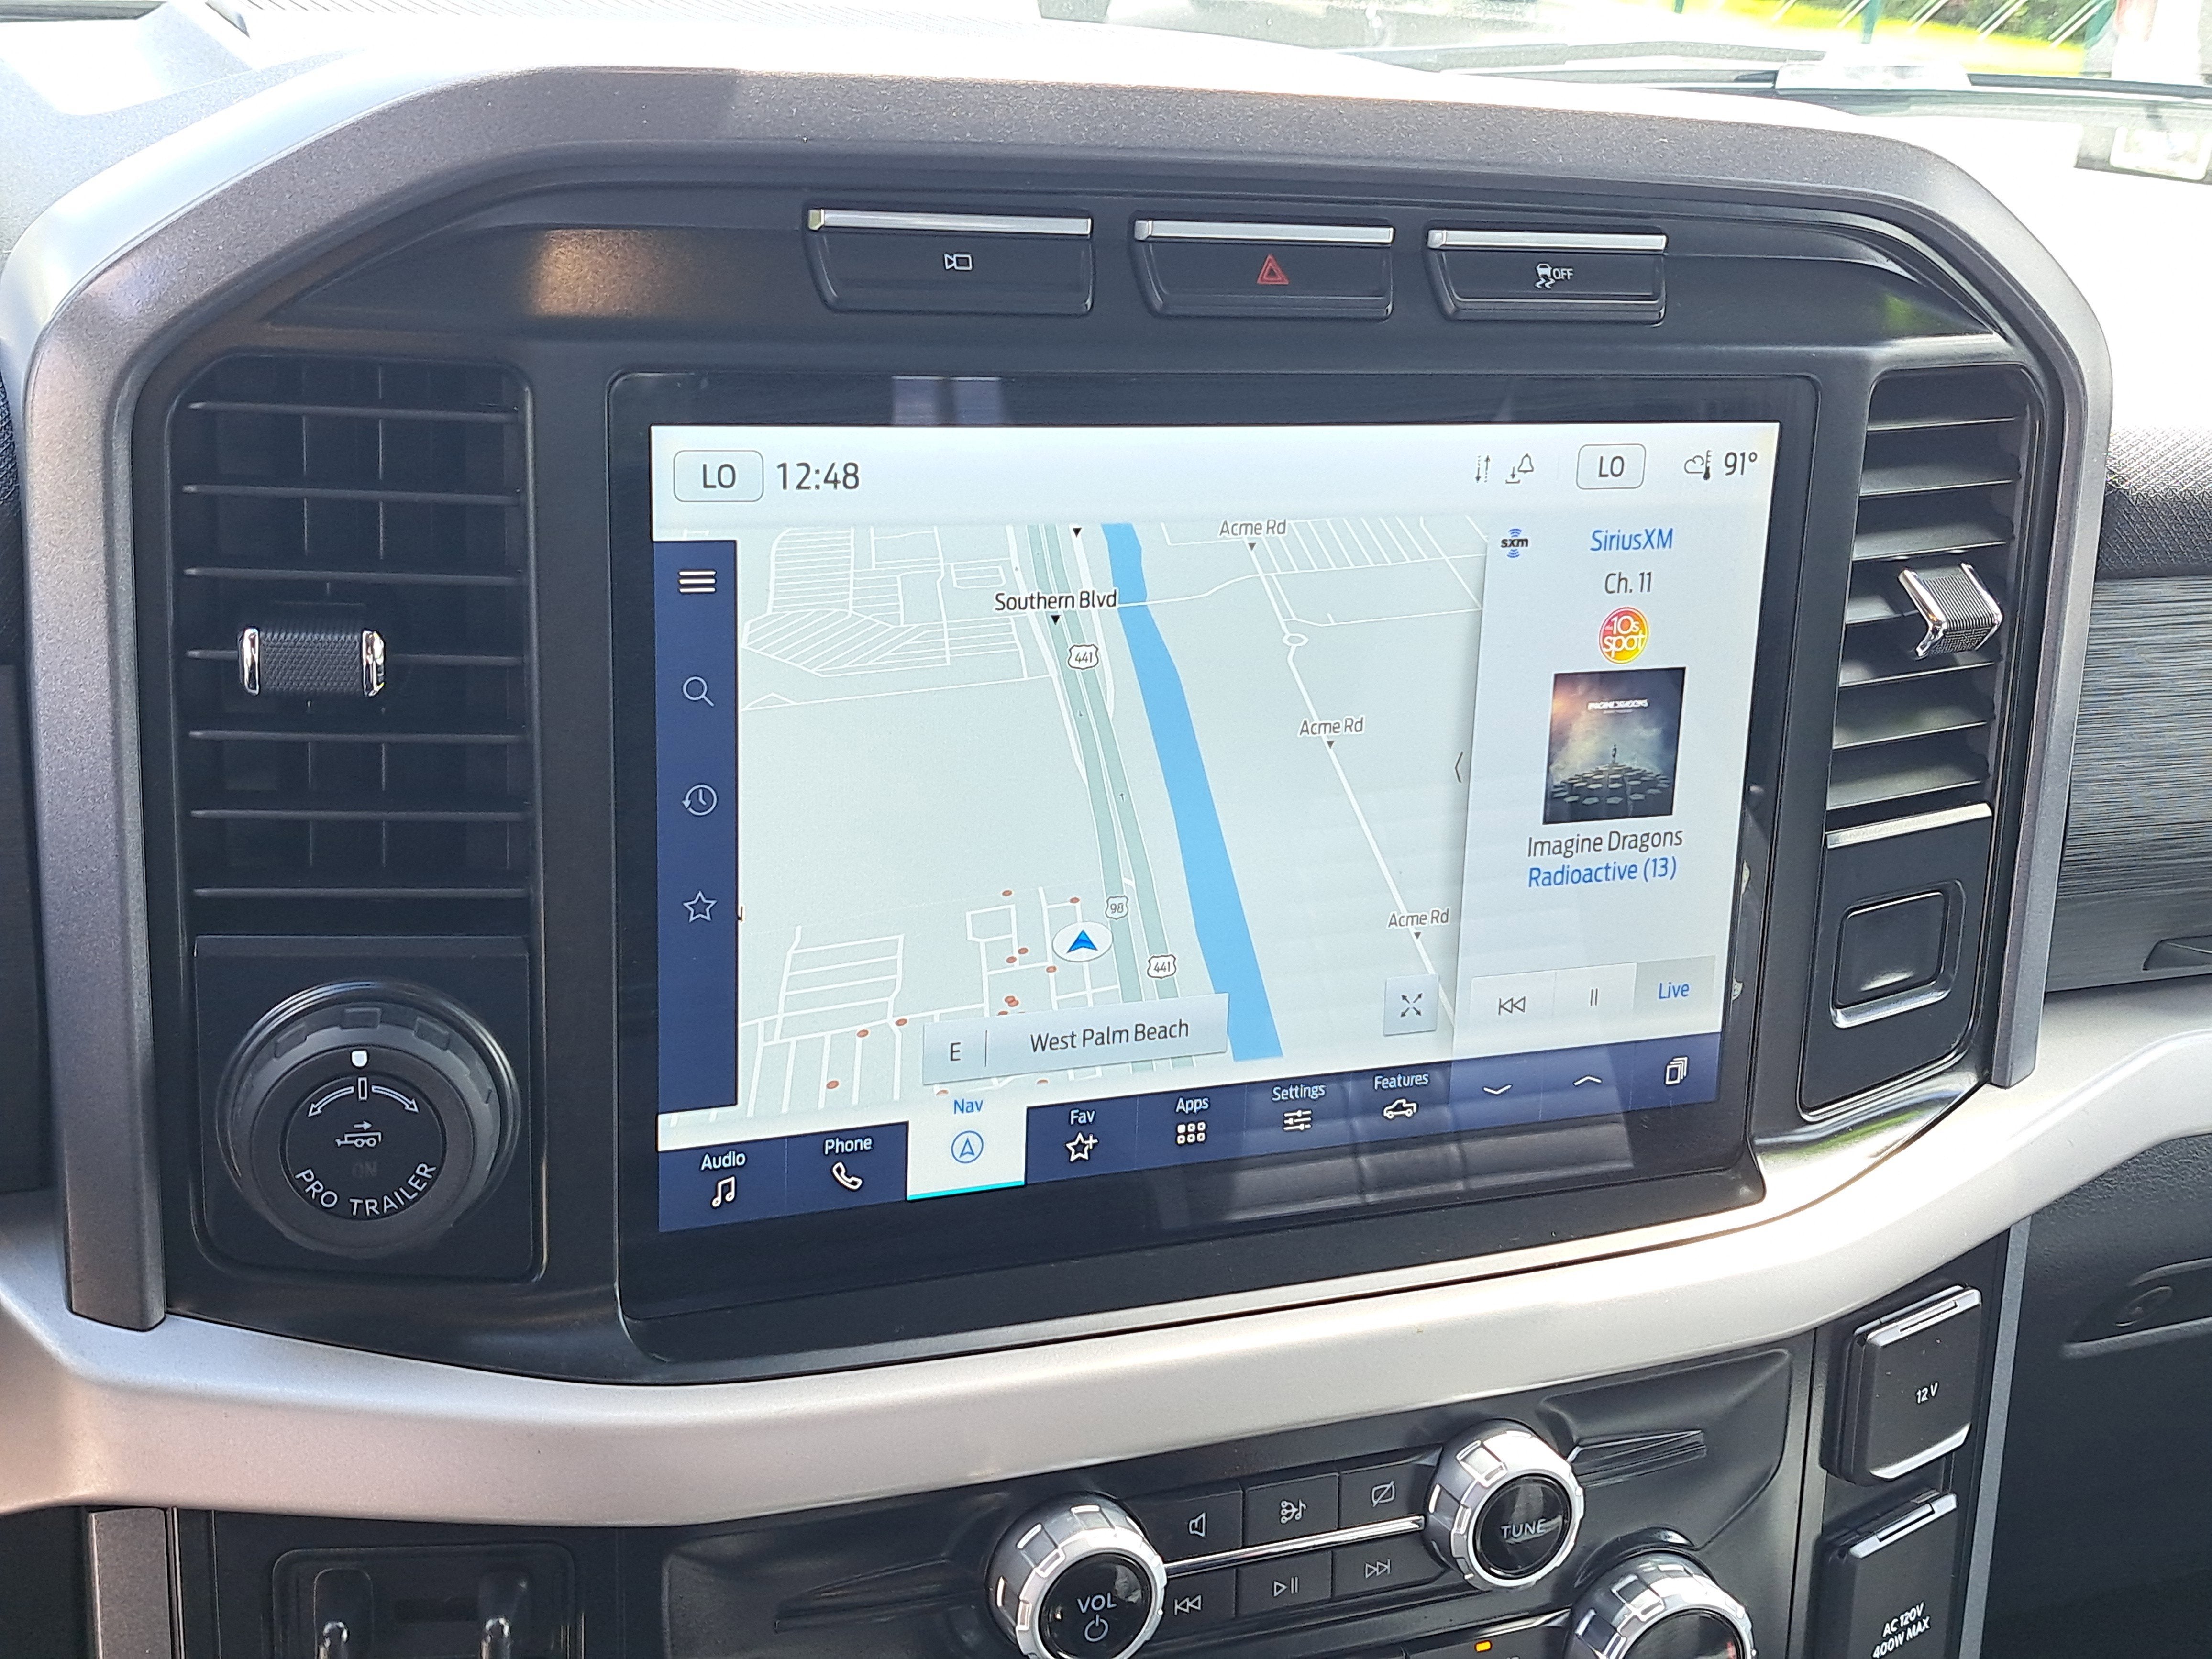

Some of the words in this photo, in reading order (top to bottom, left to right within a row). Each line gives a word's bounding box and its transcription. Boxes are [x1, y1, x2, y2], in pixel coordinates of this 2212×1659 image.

[1552, 268, 1574, 280] OFF
[702, 464, 736, 488] LO
[777, 462, 860, 490] 12:48
[1598, 456, 1625, 478] LO
[1219, 521, 1262, 536] Acme
[1265, 520, 1286, 535] Rd
[1590, 528, 1673, 551] SiriusXM
[1604, 574, 1633, 594] Ch.
[1639, 572, 1652, 593] 11
[995, 592, 1075, 611] Southern
[1080, 590, 1117, 609] Blvd
[1602, 630, 1646, 658] spot
[1074, 651, 1093, 664] 441
[1299, 719, 1340, 736] Acme
[1345, 717, 1363, 733] Rd
[1528, 833, 1603, 860] Imagine
[1609, 829, 1683, 853] Dragons
[1528, 861, 1638, 887] Radioactive
[1644, 856, 1676, 882] (13)
[1388, 911, 1427, 928] Acme
[1431, 908, 1449, 924] Rd
[1153, 961, 1172, 973] 441
[1659, 980, 1690, 1000] Live
[950, 1042, 962, 1062] E
[1030, 1031, 1077, 1052] West
[1083, 1027, 1129, 1047] Palm
[1135, 1019, 1189, 1042] Beach
[1374, 1073, 1429, 1092] Features
[1272, 1083, 1327, 1103] Settings
[953, 1100, 984, 1115] Nav
[1175, 1096, 1209, 1113] Apps
[1070, 1110, 1095, 1125] Fav
[824, 1137, 872, 1155] Phone
[352, 1162, 377, 1178] ON
[700, 1151, 745, 1171] Audio
[295, 1168, 338, 1208] PRO
[349, 1162, 437, 1217] TRAILER
[1916, 1388, 1927, 1402] 12
[1930, 1382, 1938, 1396] V
[1501, 1519, 1547, 1539] TUNE
[1077, 1592, 1117, 1614] VOL
[1882, 1618, 1899, 1637] AC
[1900, 1602, 1924, 1627] 120V
[1872, 1631, 1905, 1659] 400W
[1906, 1616, 1931, 1641] MAX
